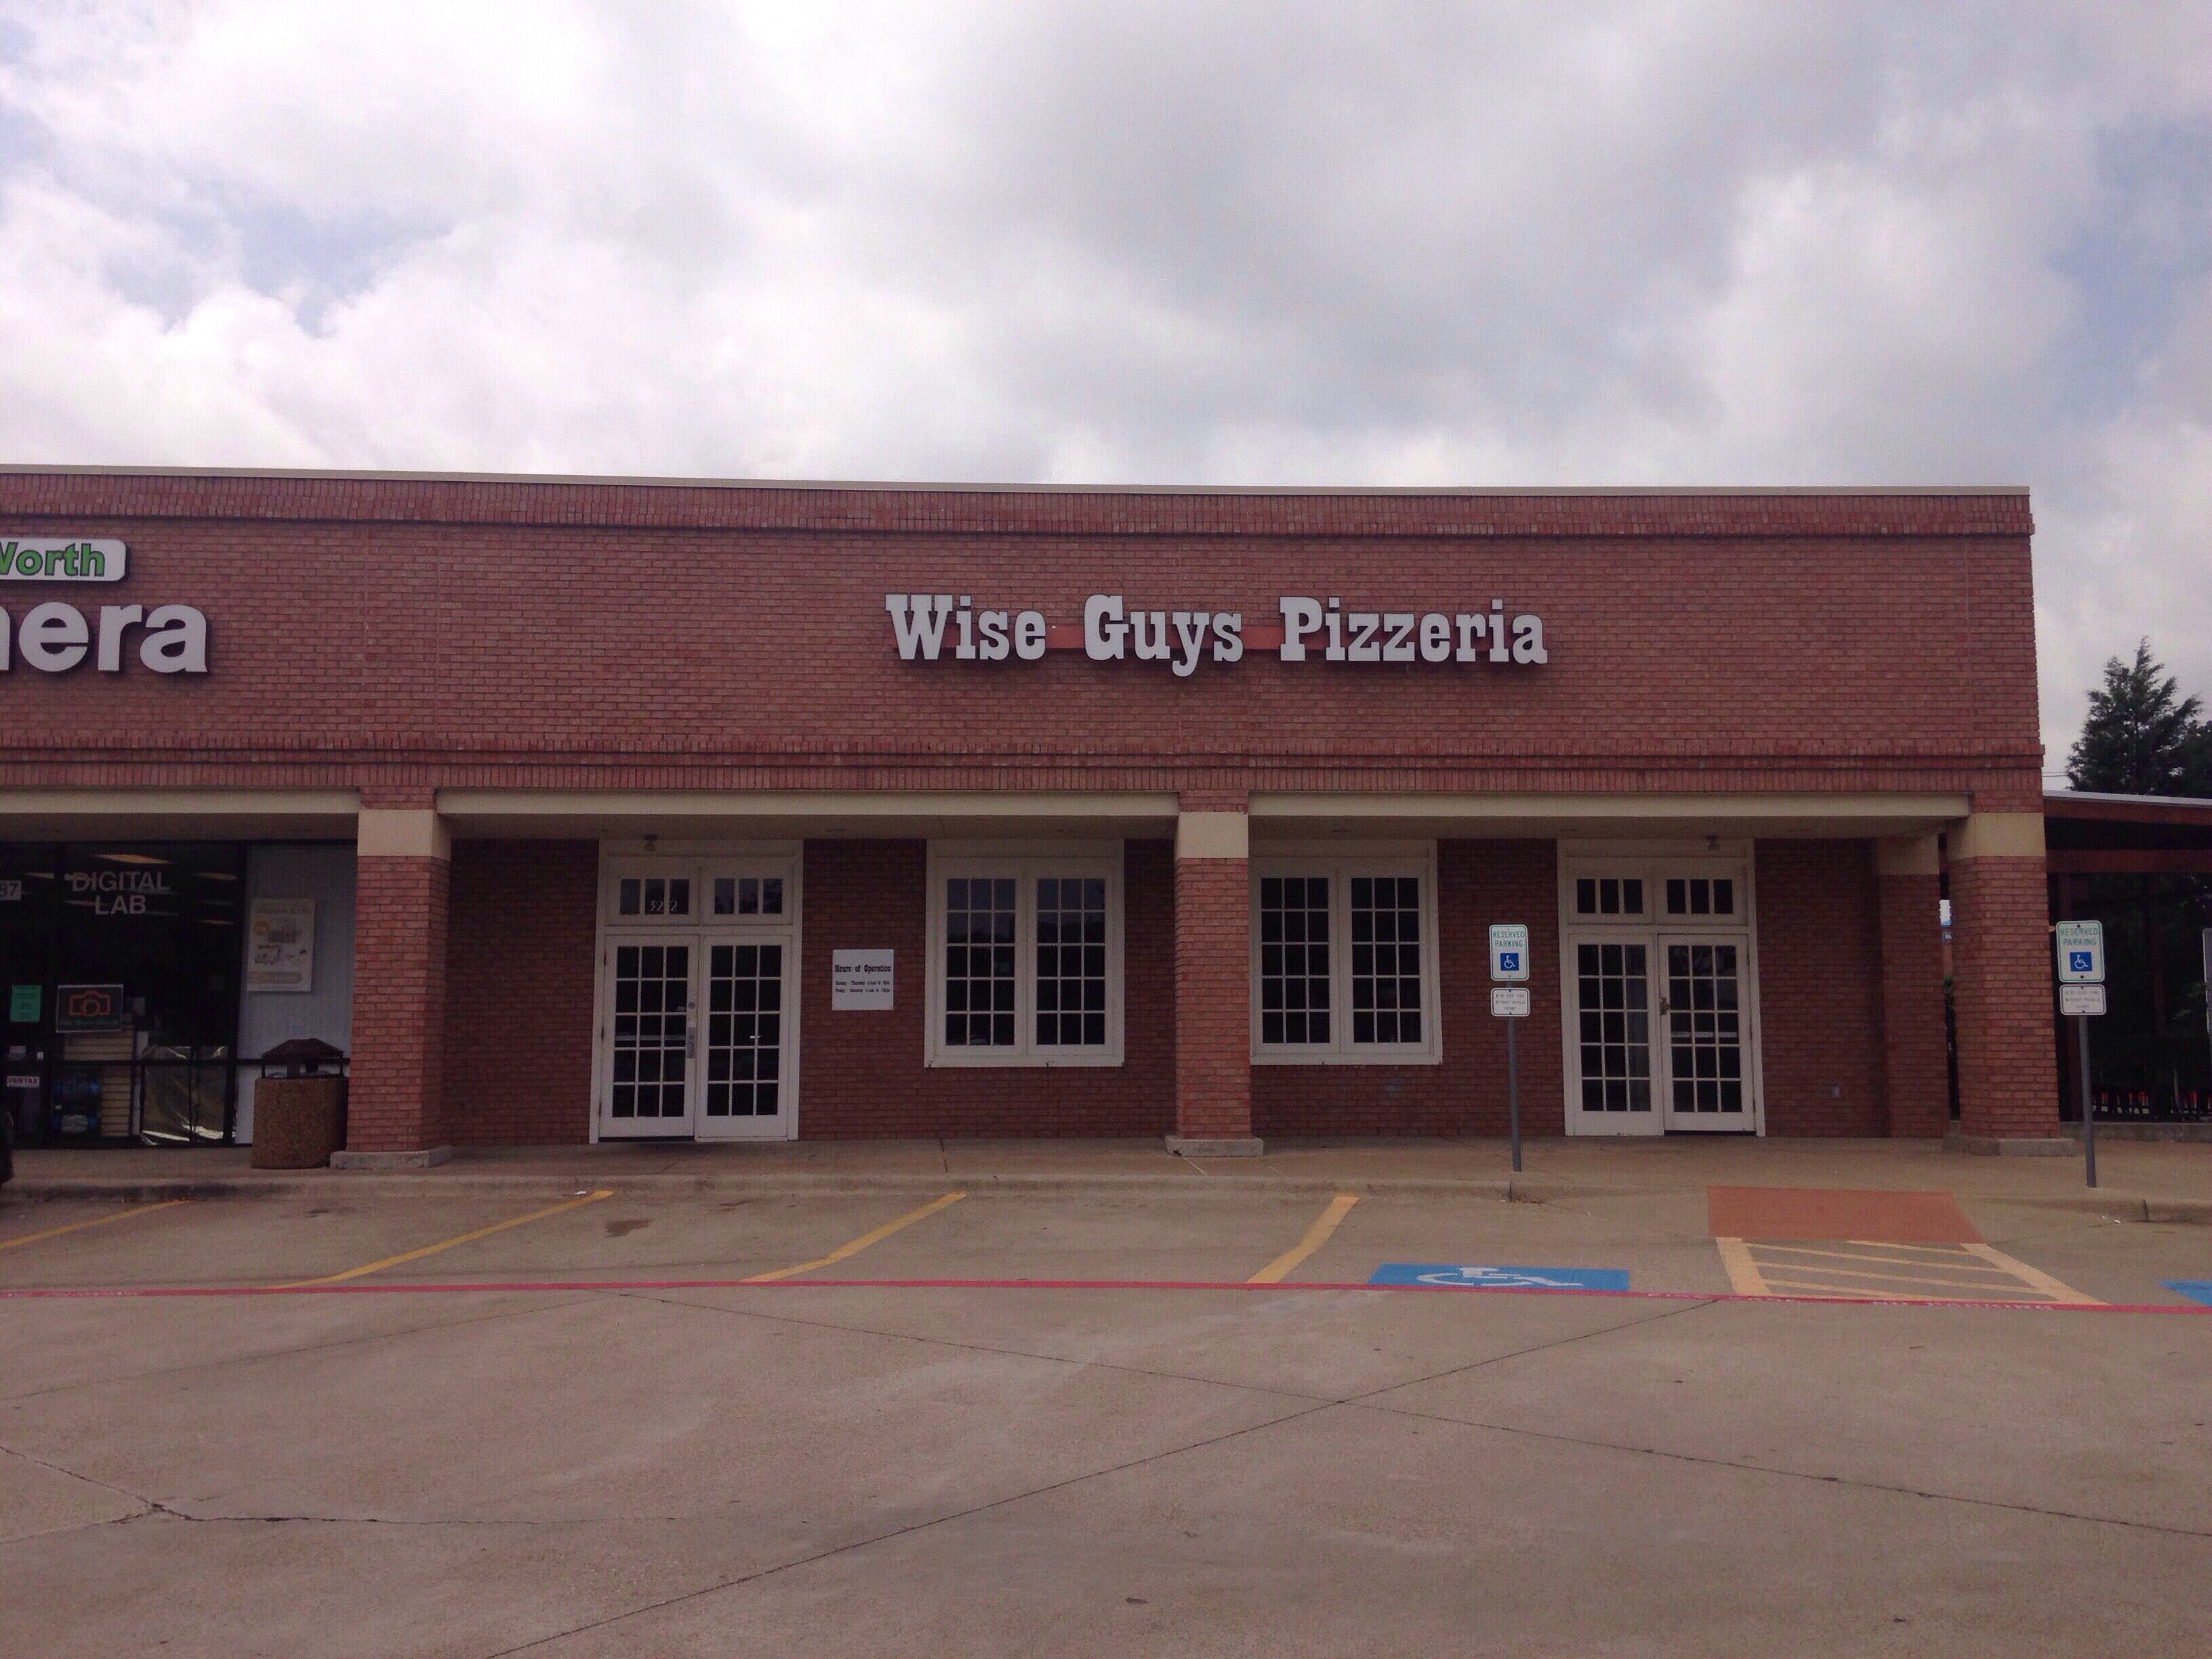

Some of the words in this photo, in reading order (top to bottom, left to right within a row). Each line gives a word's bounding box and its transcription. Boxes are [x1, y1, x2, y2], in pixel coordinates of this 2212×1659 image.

[885, 594, 1046, 661] Wise
[1084, 594, 1243, 676] Guys
[1279, 596, 1549, 665] Pizzeria
[72, 872, 170, 892] DIGITAL
[95, 895, 146, 915] LAB
[2063, 938, 2096, 946] PARKING
[864, 964, 891, 974] Operation
